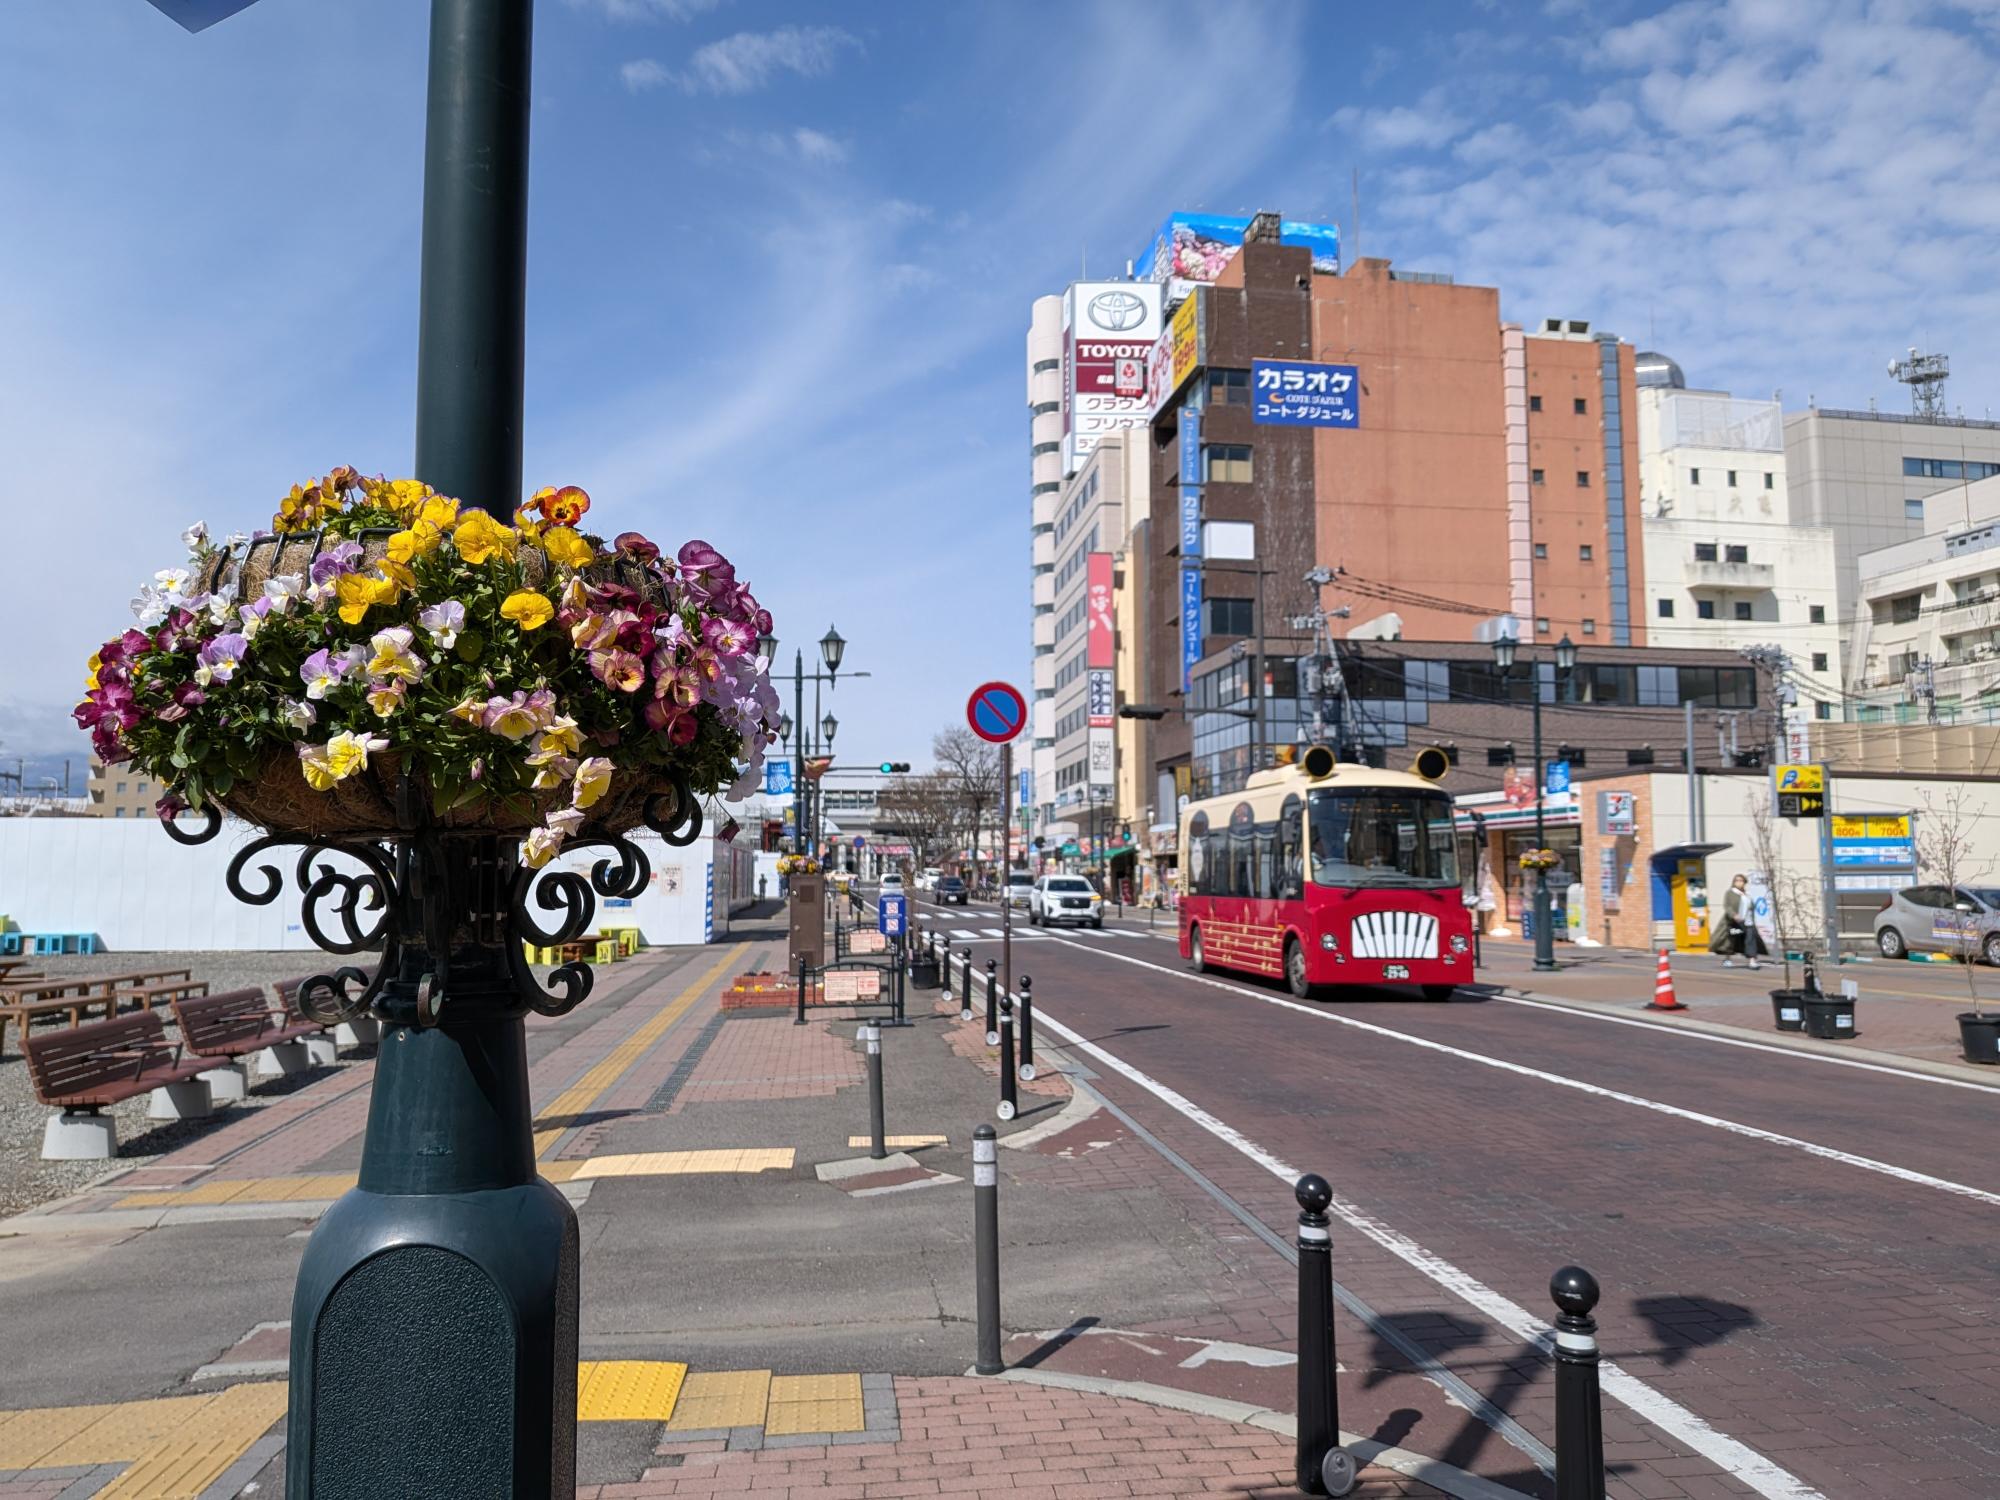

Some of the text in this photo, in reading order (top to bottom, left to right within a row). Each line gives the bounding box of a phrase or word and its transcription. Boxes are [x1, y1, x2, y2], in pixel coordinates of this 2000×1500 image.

[1258, 368, 1353, 393] カラオケ
[1257, 404, 1354, 421] コート・ダジュール
[1184, 496, 1197, 545] カラオケ
[1186, 572, 1198, 663] コート・ダジュール
